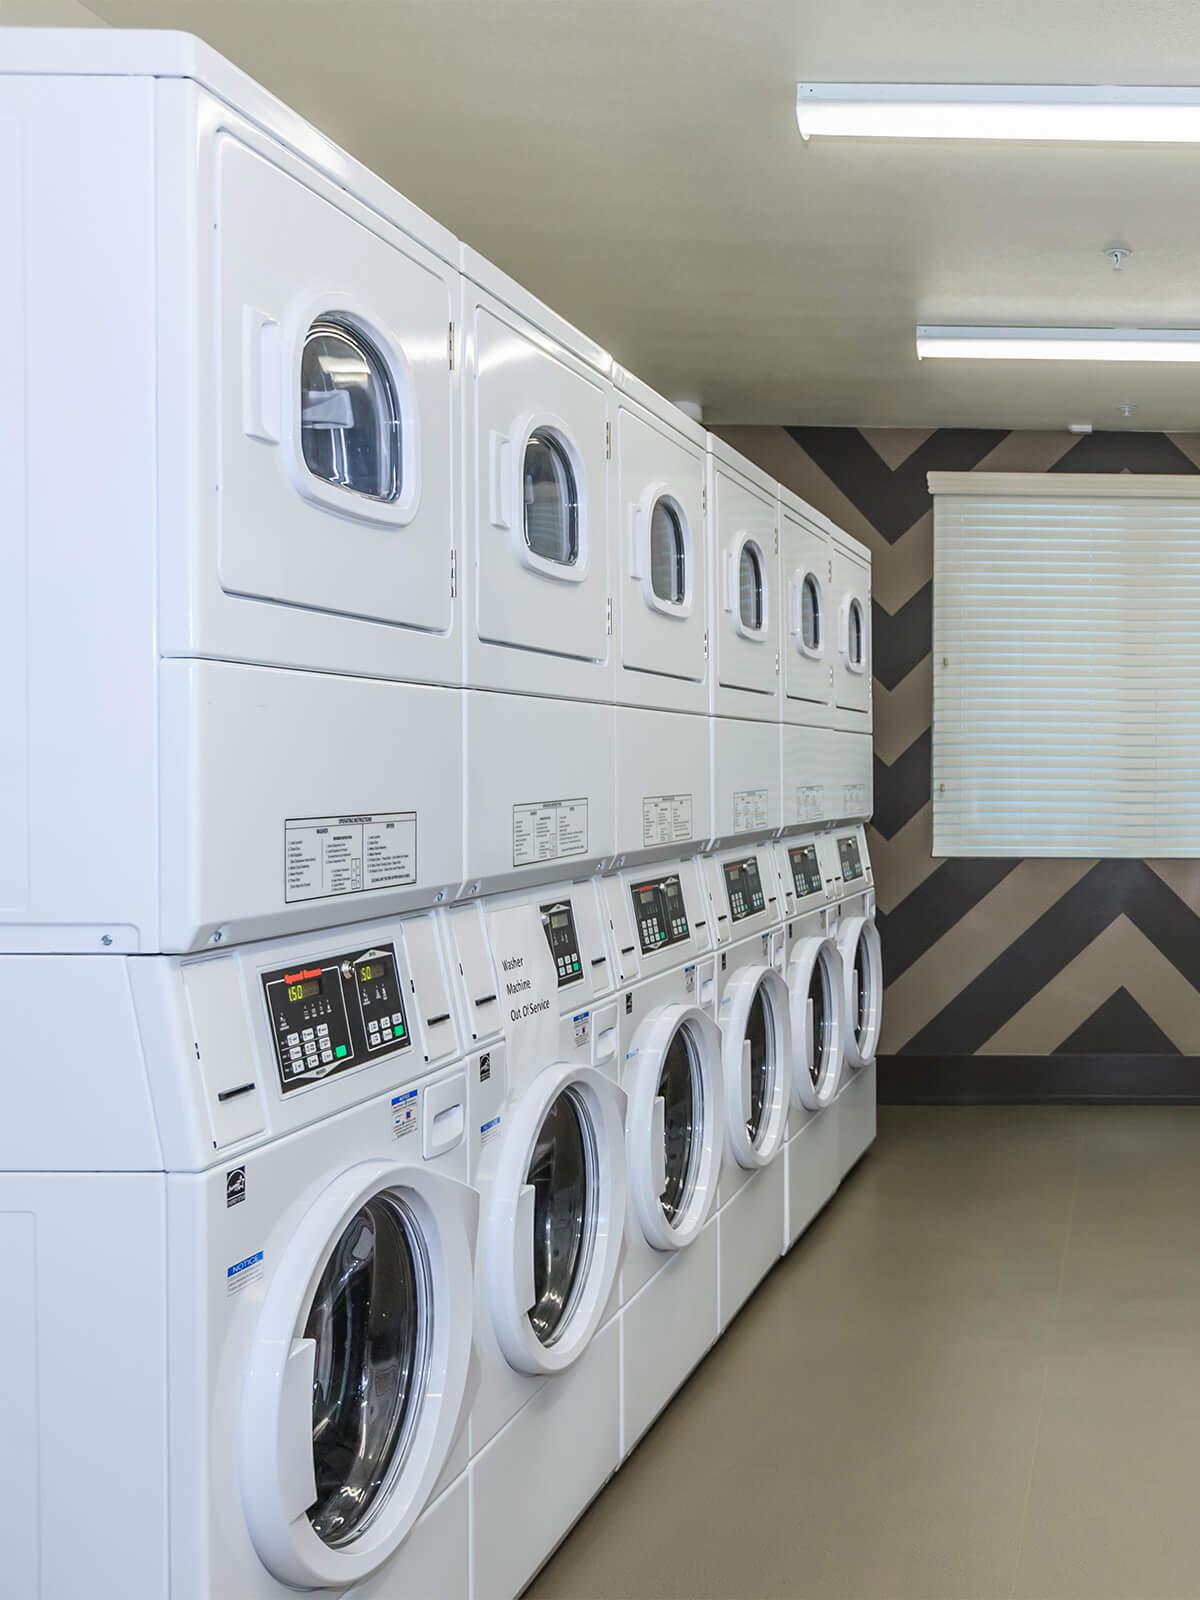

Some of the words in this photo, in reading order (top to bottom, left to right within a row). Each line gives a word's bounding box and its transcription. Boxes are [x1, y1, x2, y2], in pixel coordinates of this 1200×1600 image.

[502, 956, 524, 972] Washer
[506, 979, 532, 996] Machine
[510, 1009, 522, 1022] Out
[522, 1004, 530, 1017] Of
[529, 998, 551, 1015] Service
